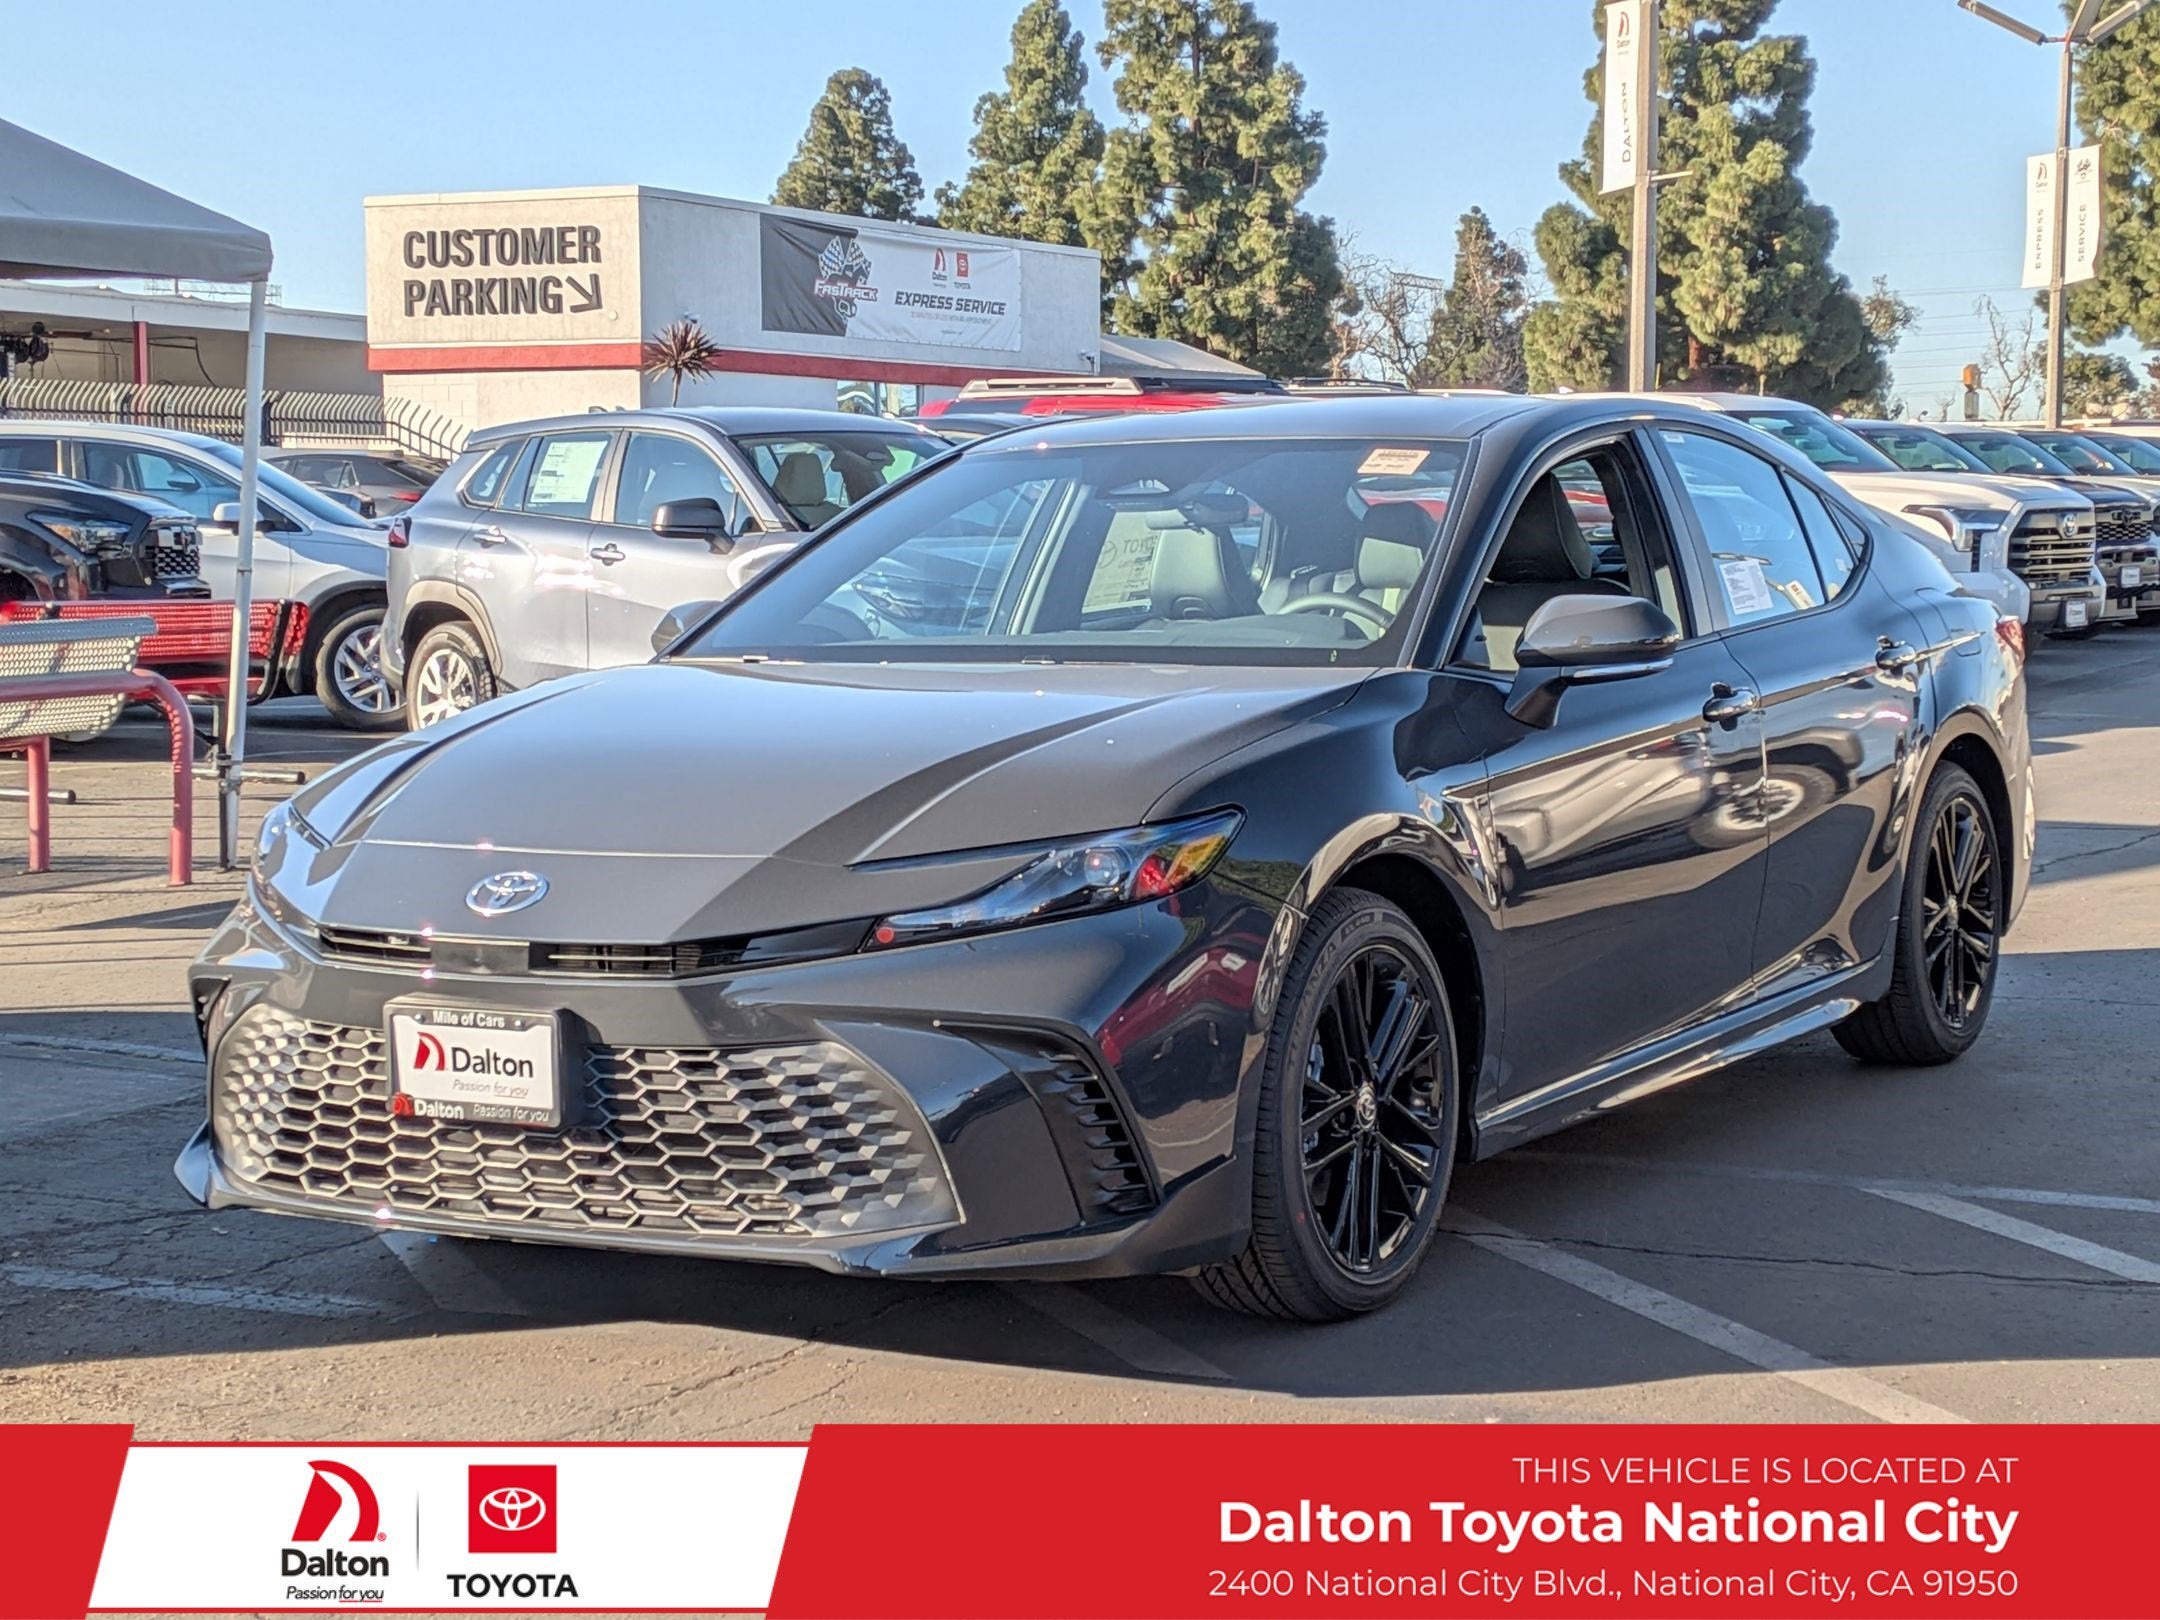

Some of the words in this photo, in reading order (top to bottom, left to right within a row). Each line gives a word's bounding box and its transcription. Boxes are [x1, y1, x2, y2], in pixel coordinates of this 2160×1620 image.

[403, 225, 602, 269] CUSTOMER
[2077, 203, 2087, 263] SERVICE
[403, 275, 563, 317] PARKING
[894, 291, 954, 310] EXPRESS
[955, 298, 1007, 316] SERVICE
[432, 1010, 458, 1025] Mile
[460, 1012, 475, 1026] of
[476, 1013, 505, 1028] Cars
[451, 1047, 533, 1078] Dalton
[452, 1079, 492, 1093] Passion
[493, 1082, 508, 1095] for
[509, 1086, 529, 1099] you
[414, 1100, 465, 1120] Dalton
[473, 1104, 511, 1119] Passion
[512, 1108, 528, 1121] for
[529, 1110, 550, 1123] you
